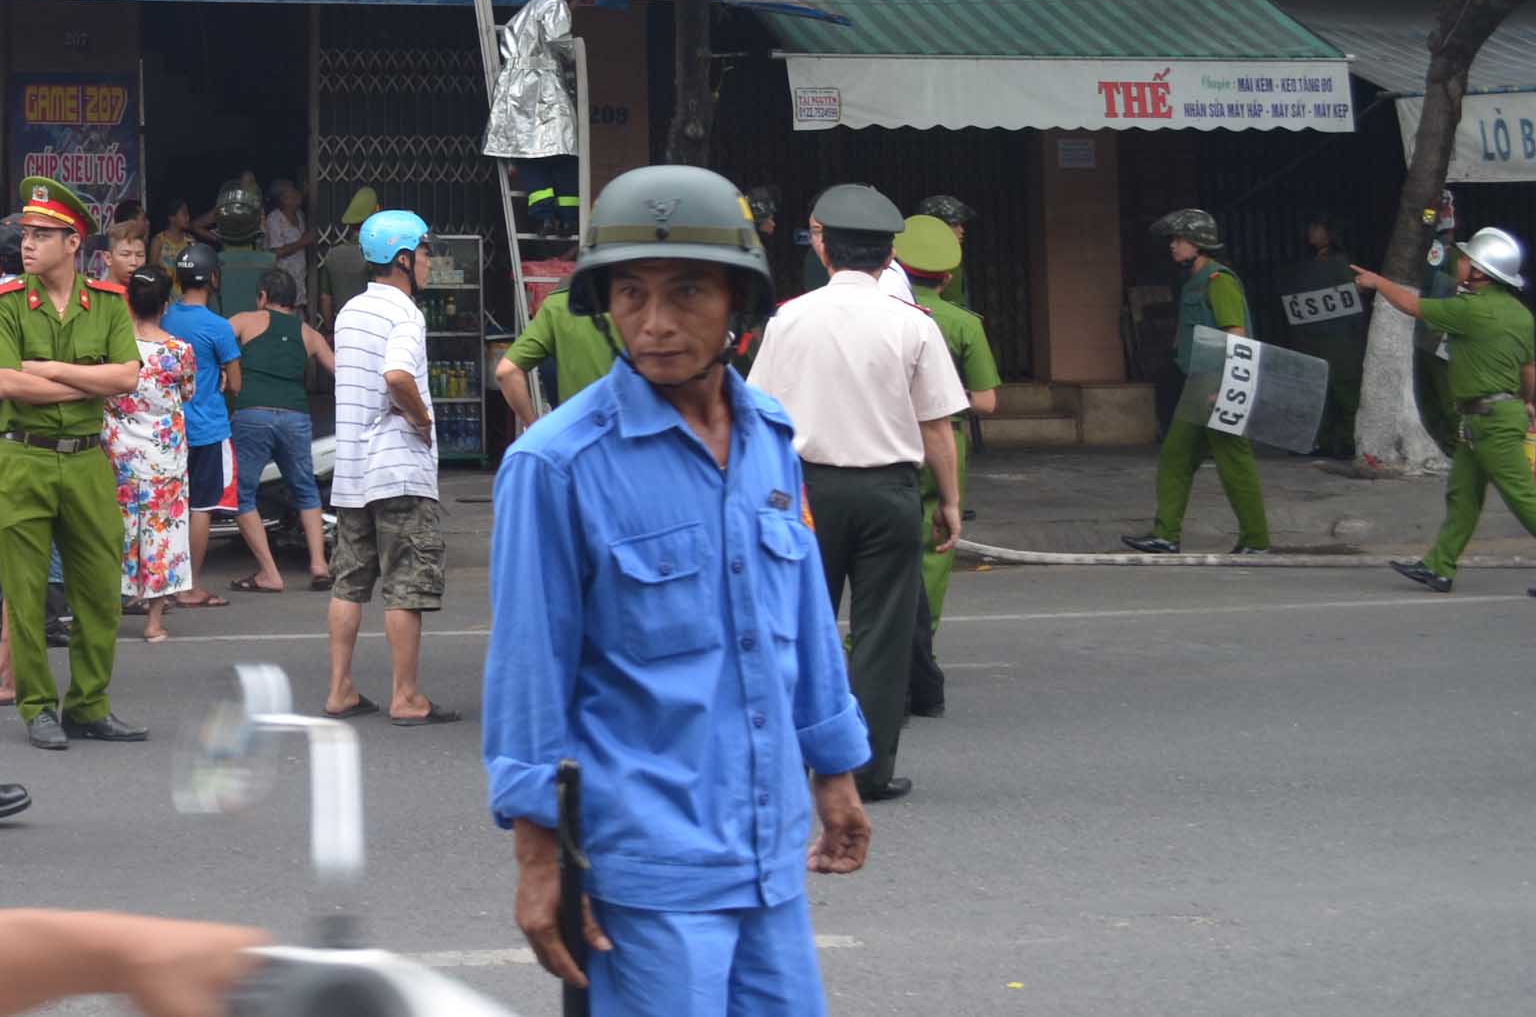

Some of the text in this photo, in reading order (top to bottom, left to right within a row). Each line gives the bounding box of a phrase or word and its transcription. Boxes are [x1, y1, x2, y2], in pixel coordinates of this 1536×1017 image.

[24, 85, 129, 124] GAME 207
[1097, 67, 1174, 119] THẾ
[1479, 107, 1512, 162] LÒ
